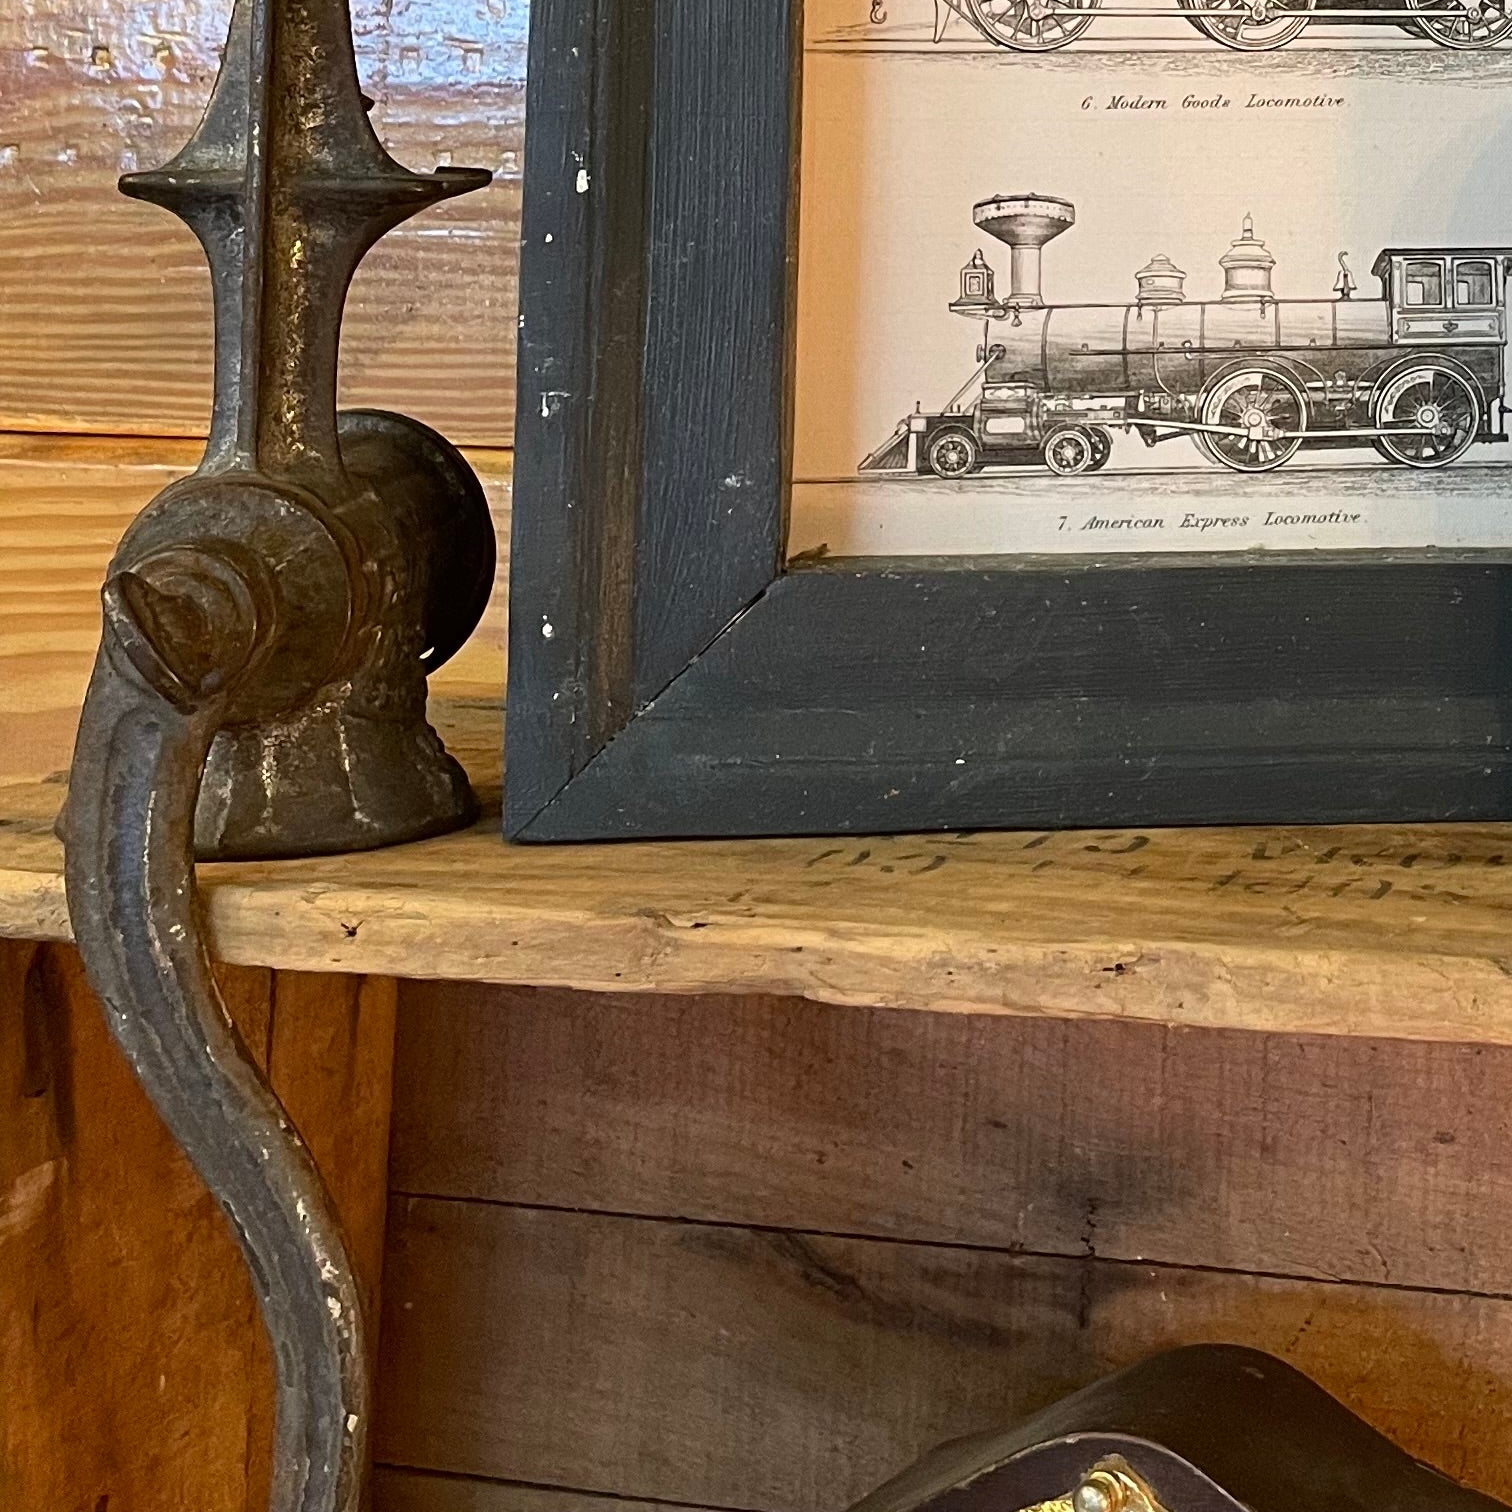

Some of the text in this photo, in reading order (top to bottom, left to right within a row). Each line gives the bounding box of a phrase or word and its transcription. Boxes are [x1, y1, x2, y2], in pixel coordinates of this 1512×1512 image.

[1105, 95, 1168, 110] Modern
[1181, 94, 1231, 109] Goods
[1080, 515, 1165, 531] American
[1179, 513, 1250, 532] Express
